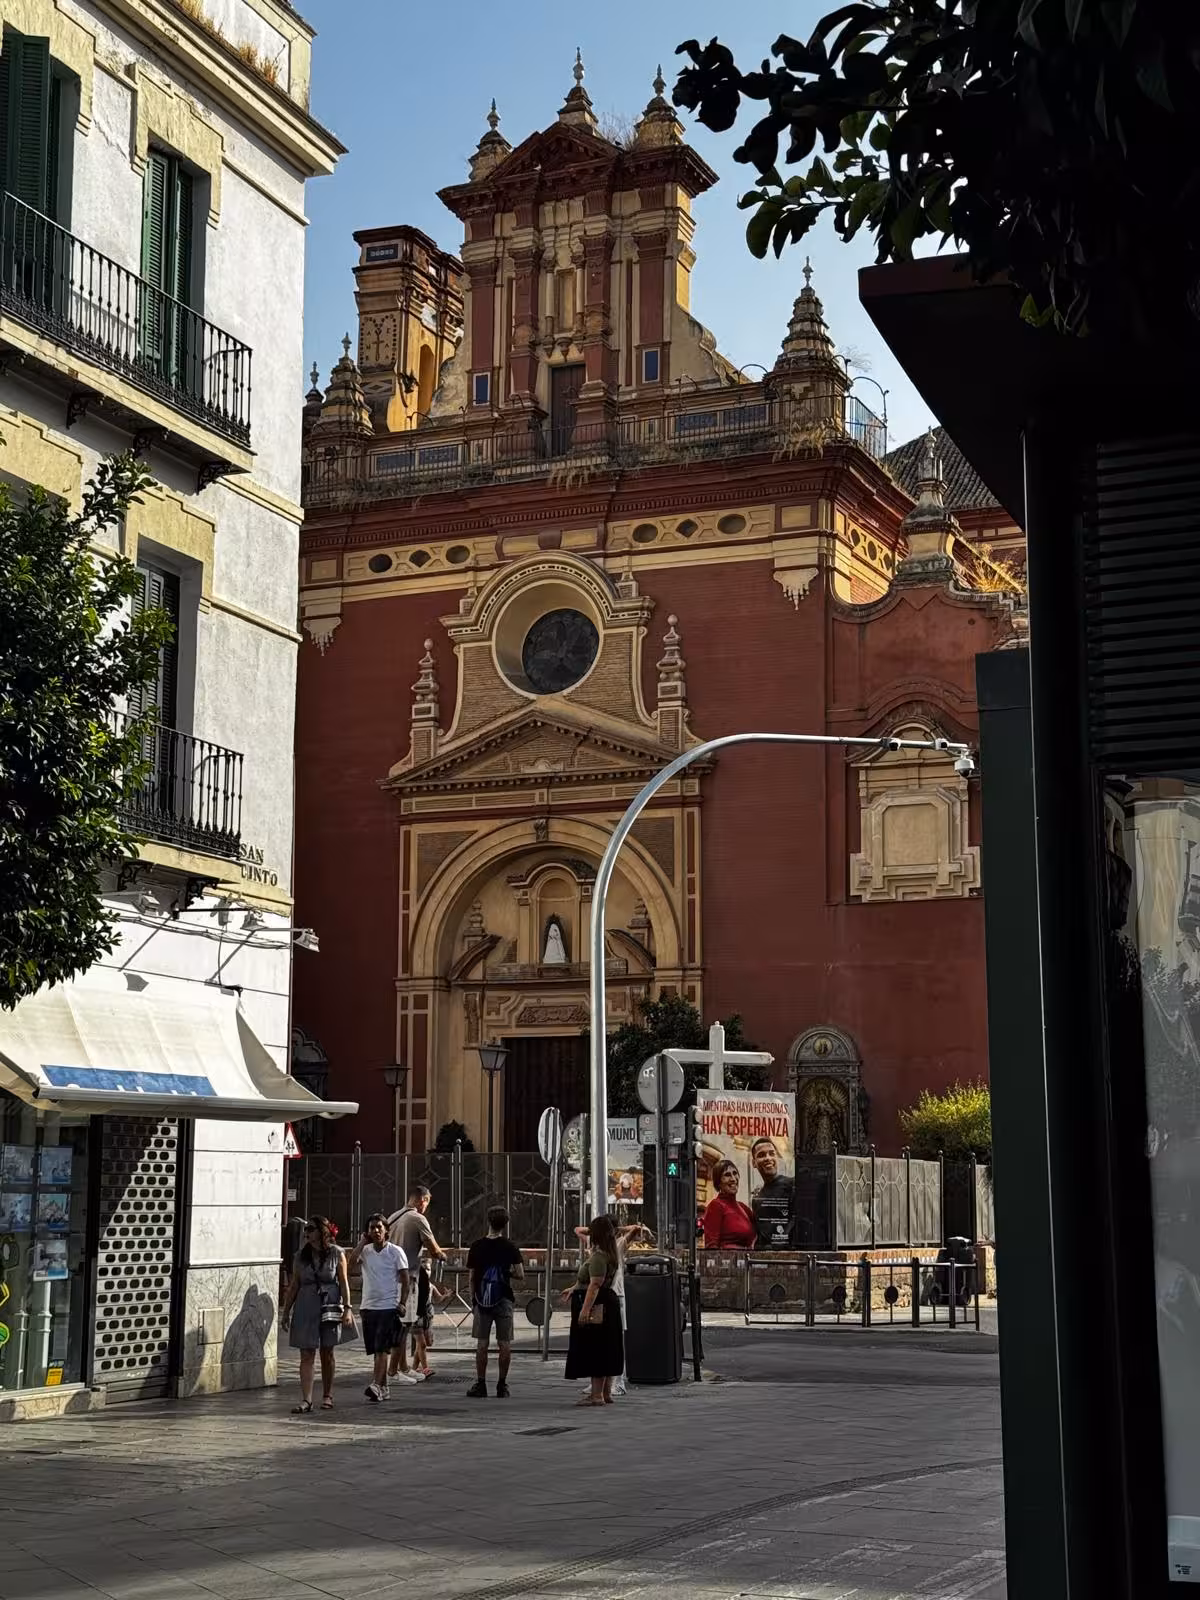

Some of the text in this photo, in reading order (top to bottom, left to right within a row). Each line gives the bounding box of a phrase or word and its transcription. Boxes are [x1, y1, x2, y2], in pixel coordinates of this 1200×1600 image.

[240, 843, 264, 863] SAN
[703, 1100, 736, 1113] MIENTRAS
[736, 1102, 753, 1114] HAYA
[702, 1115, 789, 1137] HAY ESPERANZA
